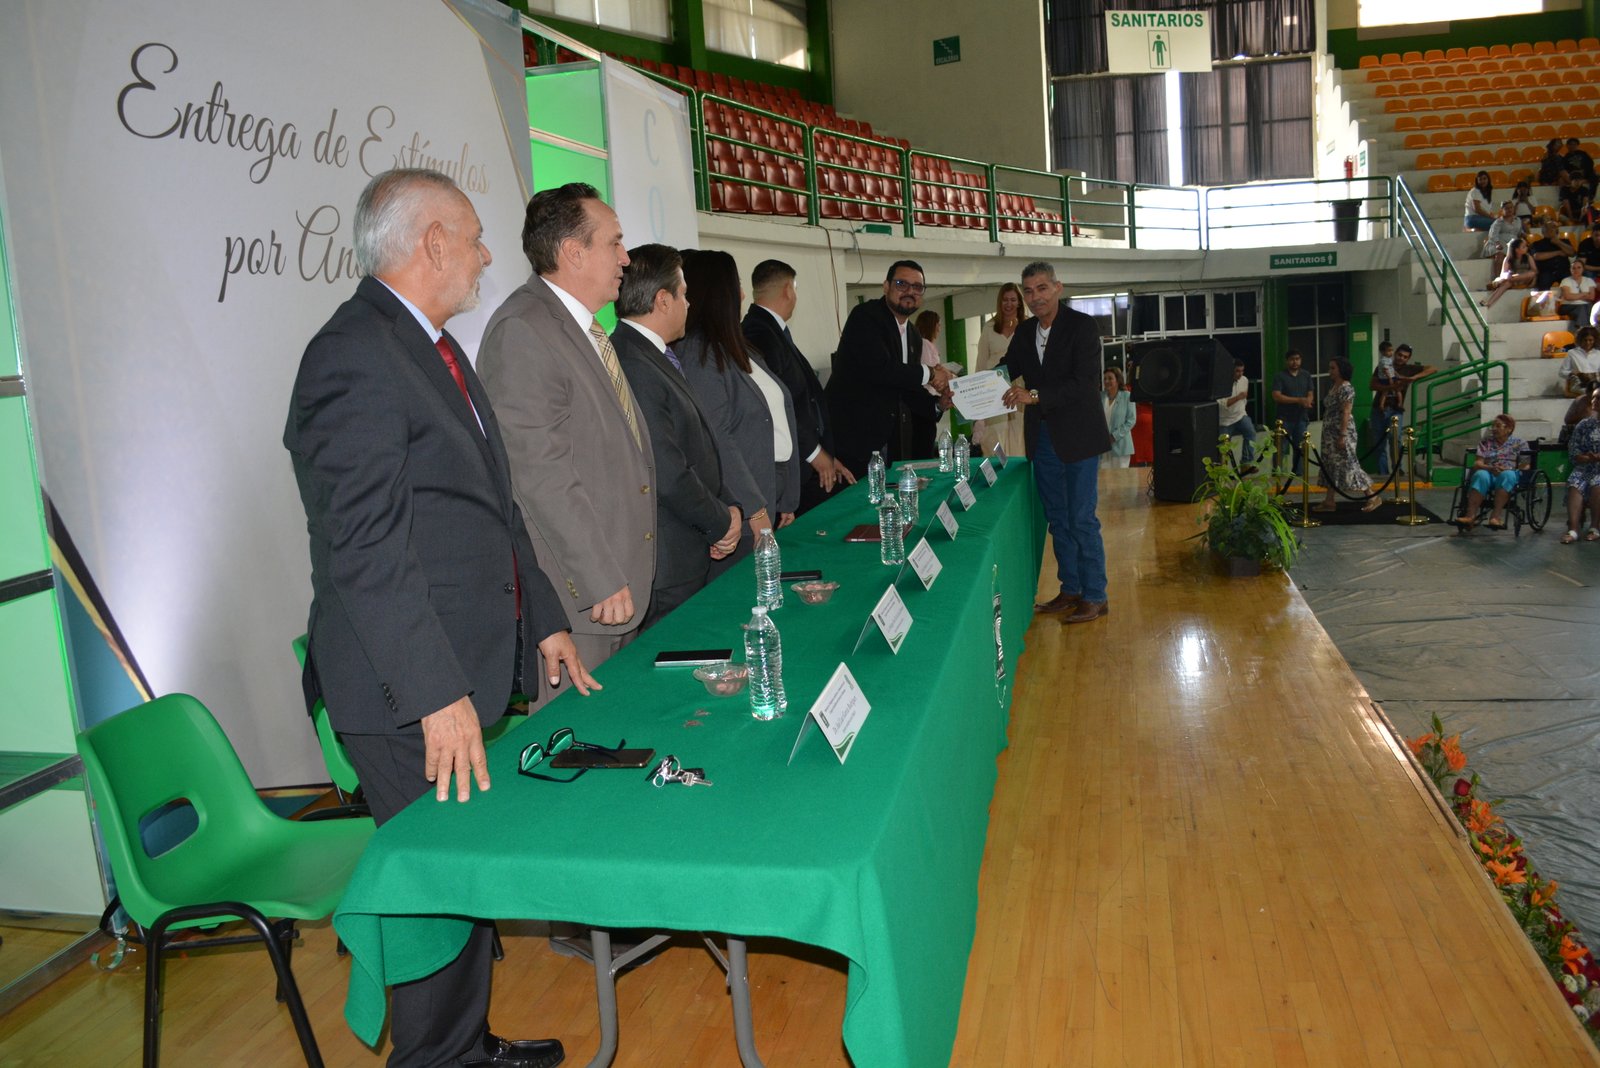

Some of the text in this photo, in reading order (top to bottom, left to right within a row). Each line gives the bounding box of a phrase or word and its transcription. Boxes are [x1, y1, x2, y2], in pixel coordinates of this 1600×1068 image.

[1110, 12, 1204, 28] SANITARIOS
[117, 42, 301, 184] Entrega
[313, 108, 350, 168] de
[217, 229, 287, 303] por
[1274, 256, 1327, 266] SANITARIOS
